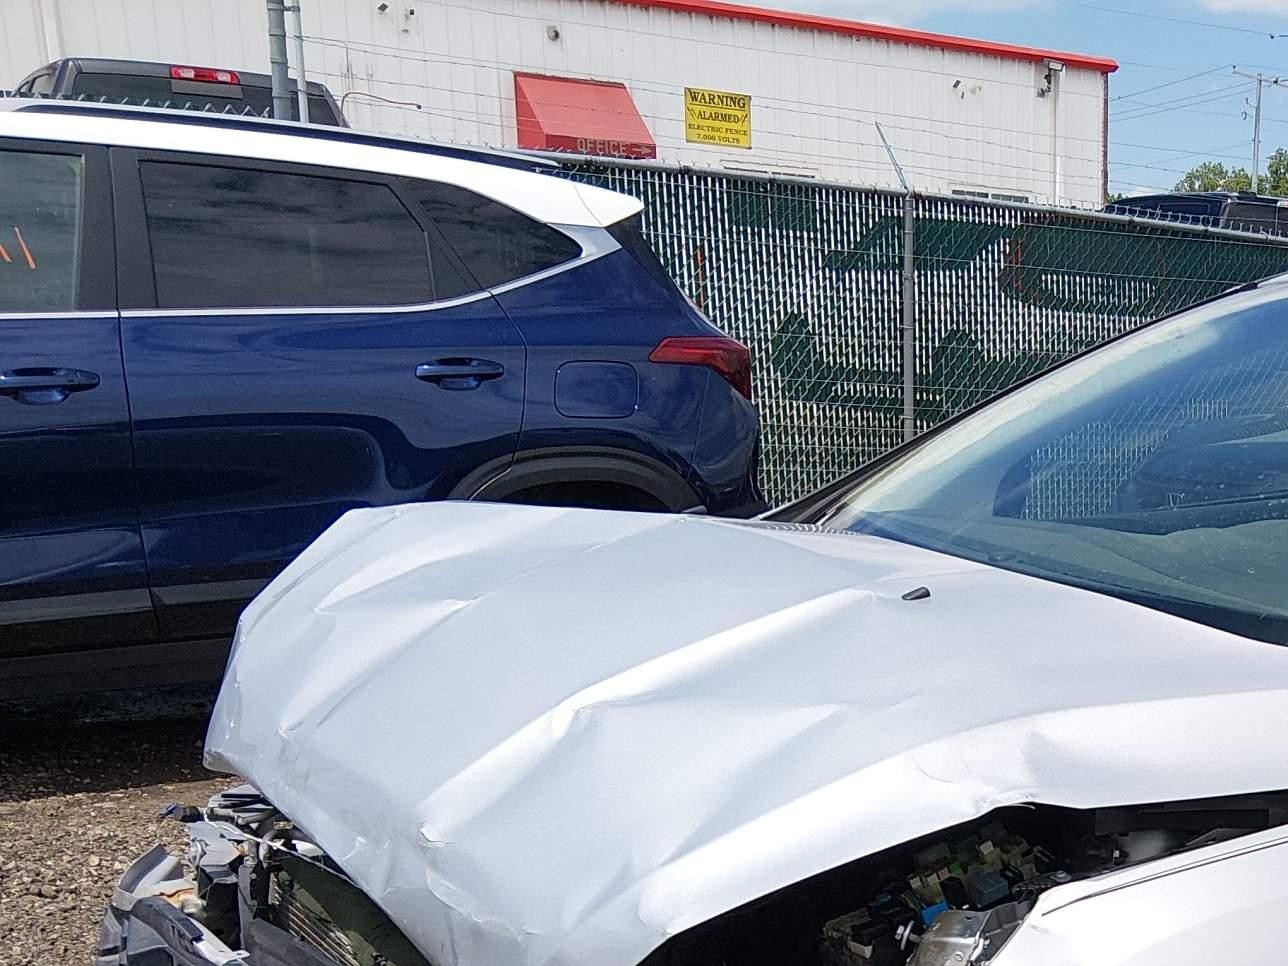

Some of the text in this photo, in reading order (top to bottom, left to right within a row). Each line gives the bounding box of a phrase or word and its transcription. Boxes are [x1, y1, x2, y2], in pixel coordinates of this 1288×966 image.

[688, 91, 746, 109] WARNING
[697, 110, 740, 124] ALARMED
[688, 123, 748, 136] ELECTRIC FENCE
[717, 135, 741, 144] VOLTS
[576, 138, 627, 156] OFFICE
